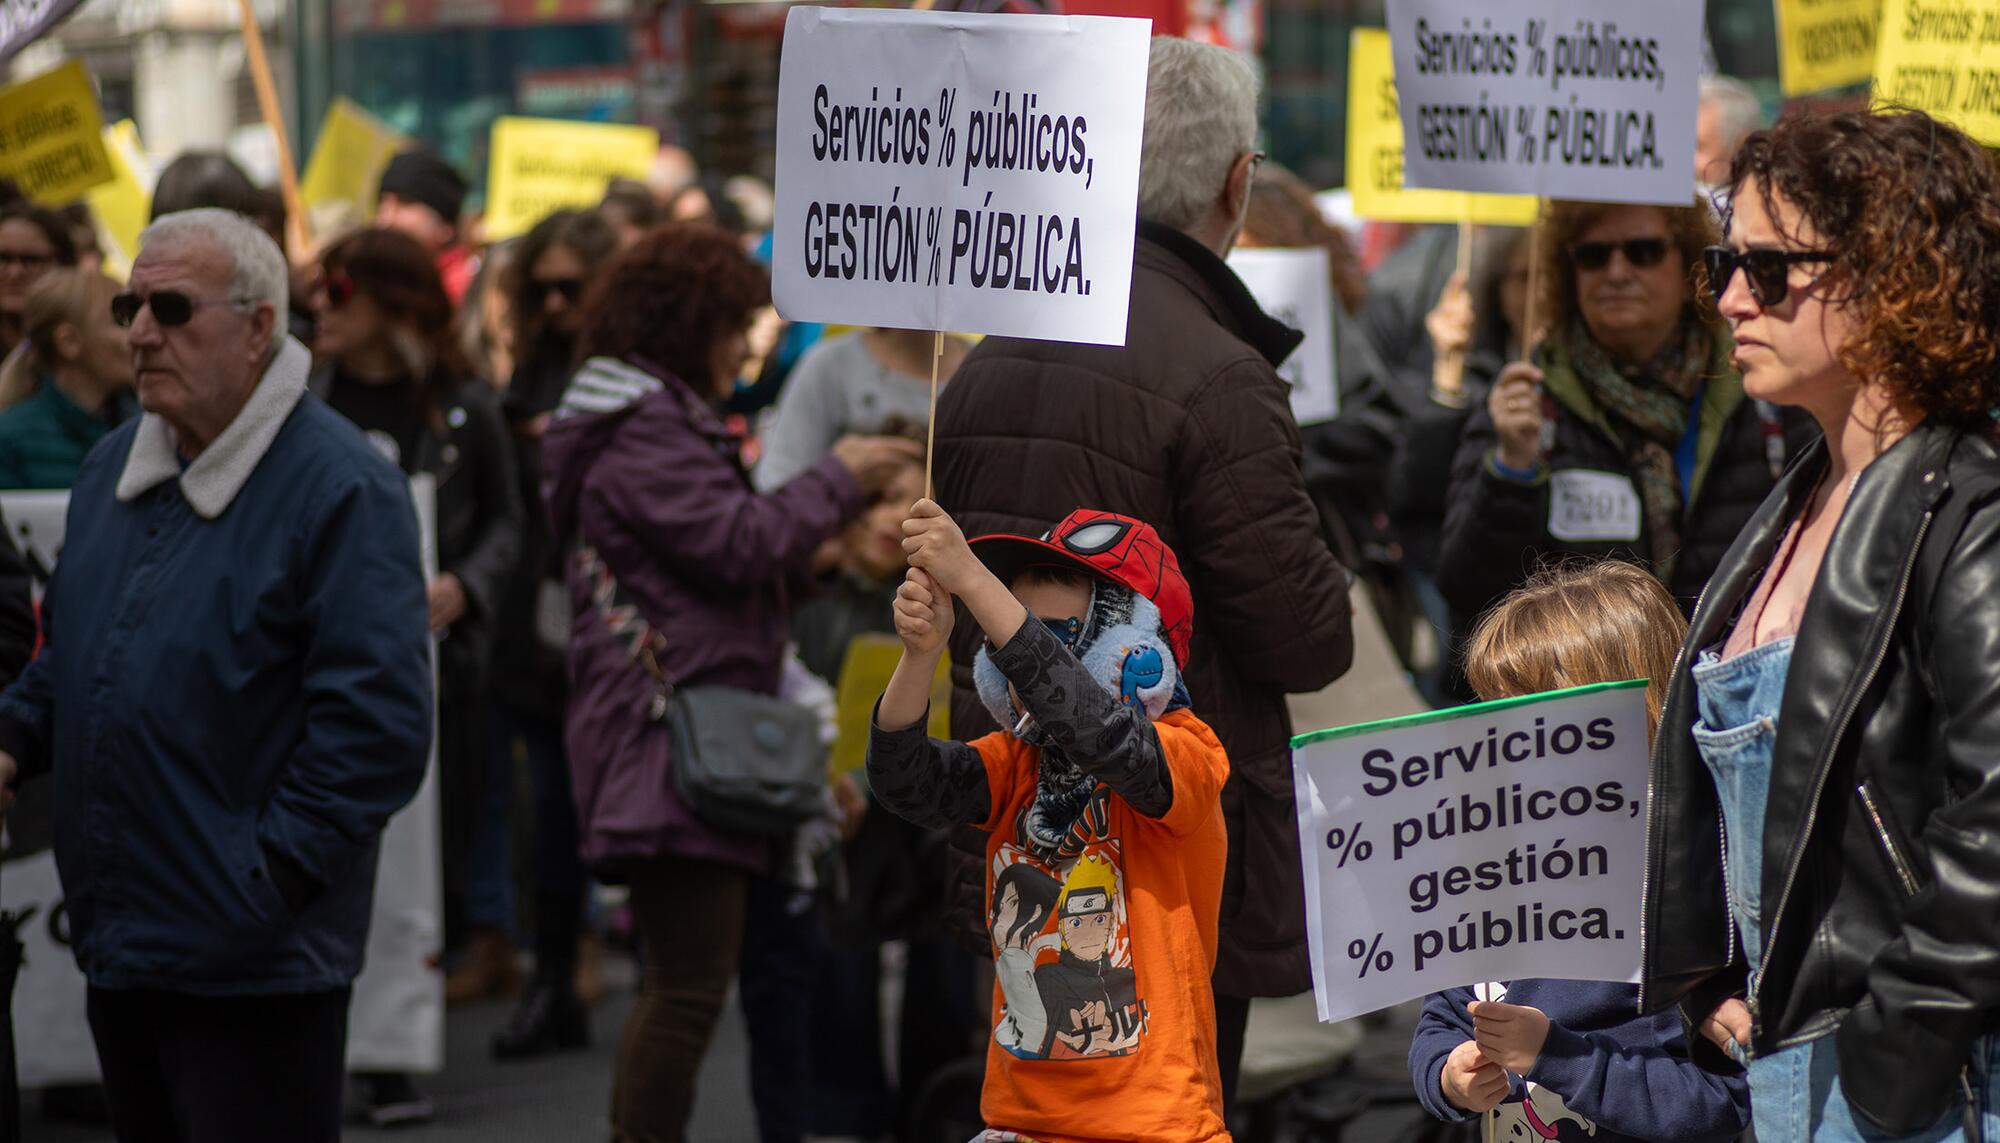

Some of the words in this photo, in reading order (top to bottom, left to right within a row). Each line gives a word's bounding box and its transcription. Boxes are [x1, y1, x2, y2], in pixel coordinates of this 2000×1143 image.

[1415, 17, 1517, 76] Servicios
[1525, 18, 1547, 78] %
[1552, 20, 1665, 91] públicos,
[812, 83, 932, 166] Servicios
[937, 87, 957, 168] %
[962, 90, 1094, 190] públicos,
[1416, 92, 1509, 163] GESTIÓN
[1516, 105, 1537, 165] %
[1542, 94, 1664, 170] PÚBLICA.
[804, 185, 922, 283] GESTIÓN
[926, 206, 943, 287] %
[948, 190, 1092, 296] PÚBLICA.
[1361, 716, 1616, 797] Servicios
[1325, 821, 1374, 869] %
[1392, 780, 1641, 861] públicos,
[1409, 838, 1609, 914] gestión
[1347, 932, 1395, 979] %
[1412, 902, 1626, 972] pública.
